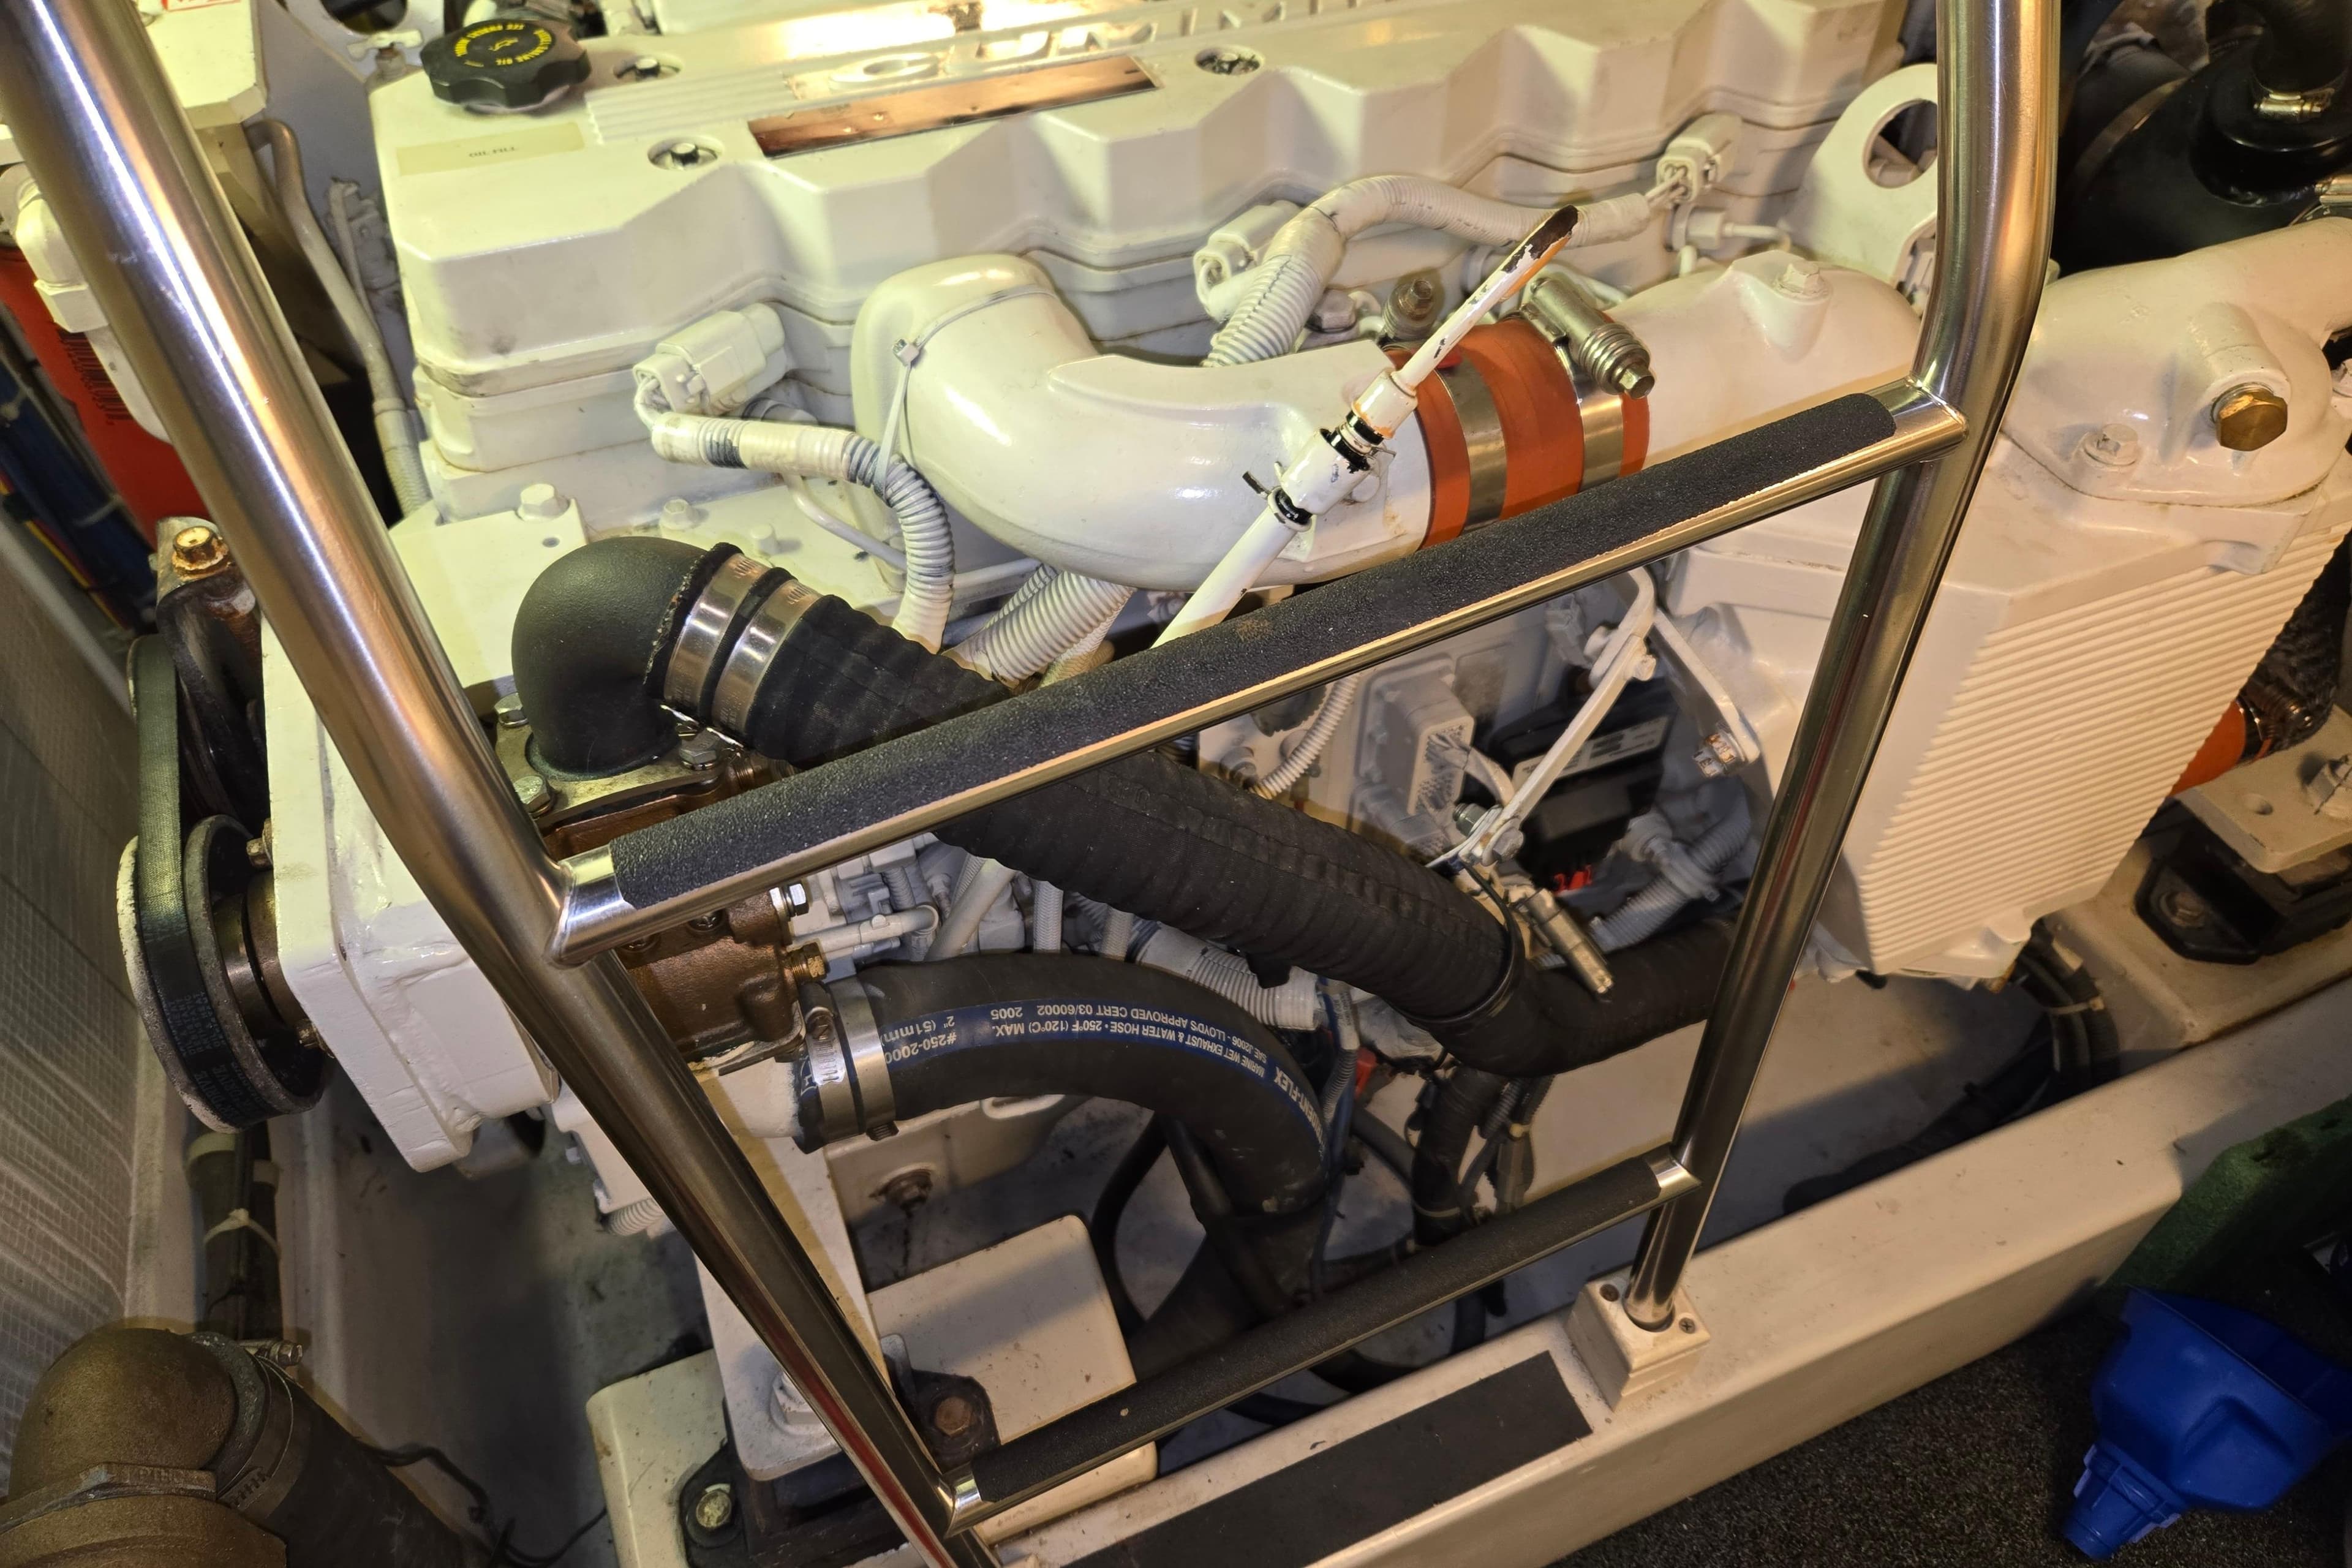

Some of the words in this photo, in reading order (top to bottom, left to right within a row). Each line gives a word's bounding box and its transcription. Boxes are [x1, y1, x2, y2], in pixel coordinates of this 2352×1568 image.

[990, 1007, 1023, 1020] 2005
[1037, 1005, 1093, 1016] 03/60002
[1096, 1005, 1128, 1017] CERT
[944, 1016, 955, 1029] 2"
[1131, 1008, 1188, 1028] APPROVED
[992, 1023, 1025, 1037] MAX.
[1028, 1020, 1069, 1033] (120°C)
[1072, 1020, 1102, 1031] 250°F
[1110, 1021, 1139, 1035] HOSE
[1191, 1020, 1225, 1041] LLOYD'S
[880, 1020, 937, 1046] (51mm)
[1142, 1025, 1175, 1041] WATER
[1178, 1031, 1185, 1043] &
[1185, 1034, 1223, 1056] EXHAUST
[1232, 1037, 1253, 1053] J2006
[1224, 1049, 1240, 1063] WET
[1254, 1047, 1267, 1063] SAE
[1242, 1058, 1265, 1077] MARINE
